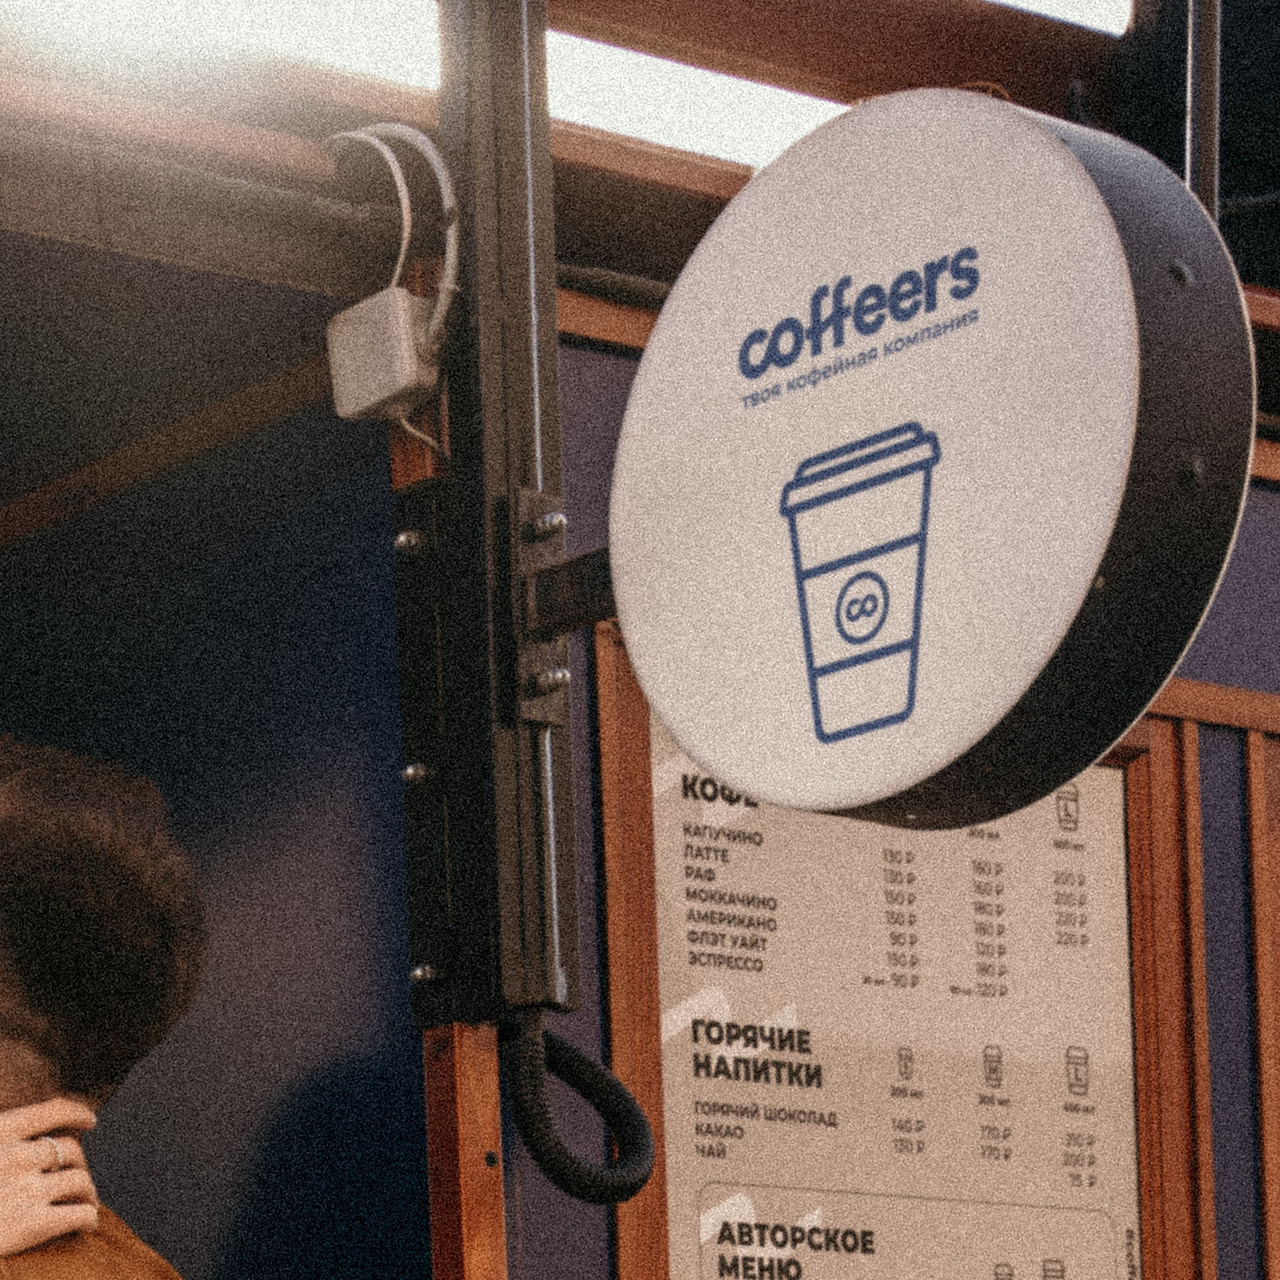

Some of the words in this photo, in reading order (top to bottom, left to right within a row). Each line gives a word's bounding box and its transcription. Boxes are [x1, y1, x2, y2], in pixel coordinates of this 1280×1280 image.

[739, 246, 979, 379] coffeers
[741, 384, 780, 408] твоя
[787, 347, 877, 388] кофейная
[884, 309, 978, 356] компания
[682, 774, 759, 808] КОФ
[682, 823, 764, 847] КАПУЧИНО
[684, 843, 729, 865] ЛАТТЕ
[685, 864, 716, 882] РАФ
[685, 886, 778, 912] МОККАЧИНО
[686, 908, 778, 933] АМЕРИКАНО
[687, 930, 727, 950] ФЛЭТ
[730, 934, 768, 954] УАЙТ
[688, 950, 764, 973] ЭСПРЕССО
[691, 1018, 812, 1056] ГОРЯЧИЕ
[693, 1053, 823, 1090] НАПИТКИ
[694, 1099, 760, 1121] ГОРЯЧИЙ
[763, 1105, 839, 1129] ШОКОЛАД
[694, 1122, 746, 1140] КАКАО
[695, 1141, 727, 1159] ЧАЙ
[717, 1220, 876, 1256] АВТОРСКОЕ
